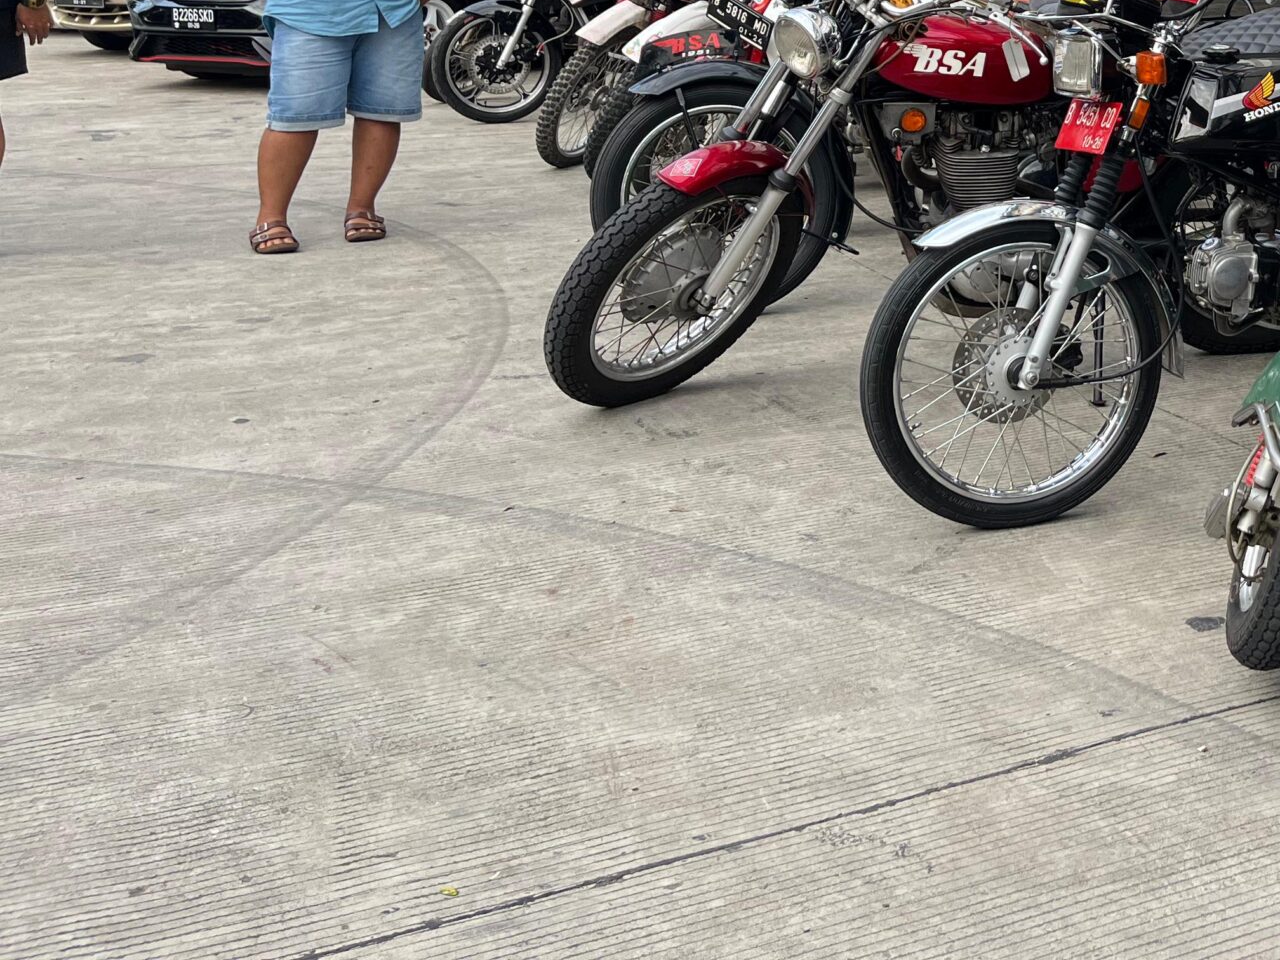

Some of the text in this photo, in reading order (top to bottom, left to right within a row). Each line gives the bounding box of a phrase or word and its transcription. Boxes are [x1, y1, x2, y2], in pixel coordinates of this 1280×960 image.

[725, 1, 748, 23] 5816
[752, 19, 768, 36] MD
[660, 32, 721, 54] BSA
[738, 26, 763, 45] 01-24
[913, 47, 987, 77] BSA
[1064, 102, 1076, 124] B
